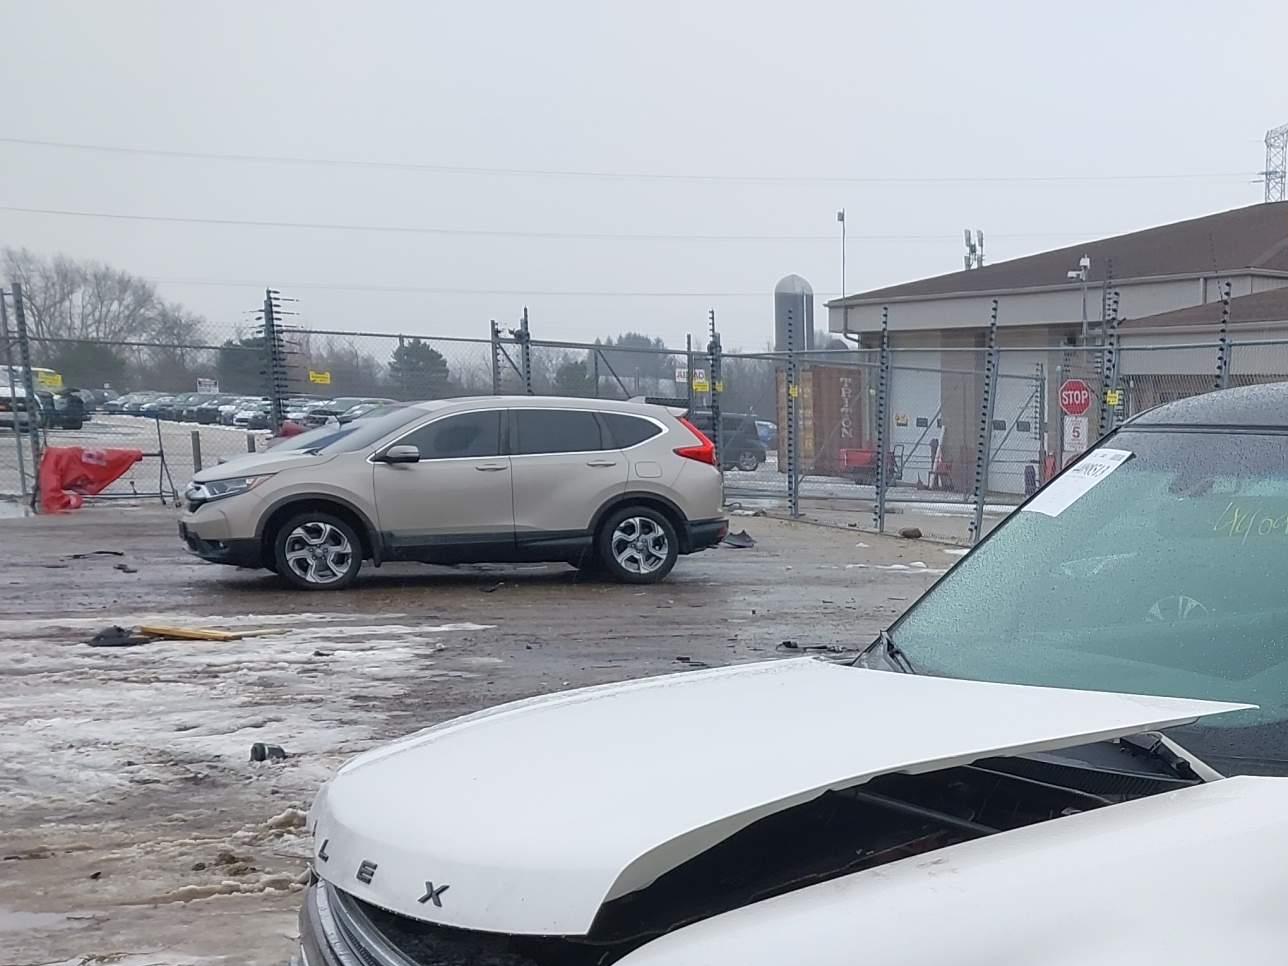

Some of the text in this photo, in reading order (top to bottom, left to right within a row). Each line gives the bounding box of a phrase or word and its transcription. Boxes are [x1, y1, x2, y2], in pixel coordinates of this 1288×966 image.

[840, 377, 853, 438] TRITON
[1062, 390, 1088, 405] STOP
[1071, 426, 1080, 439] 5
[312, 820, 450, 908] LEX
